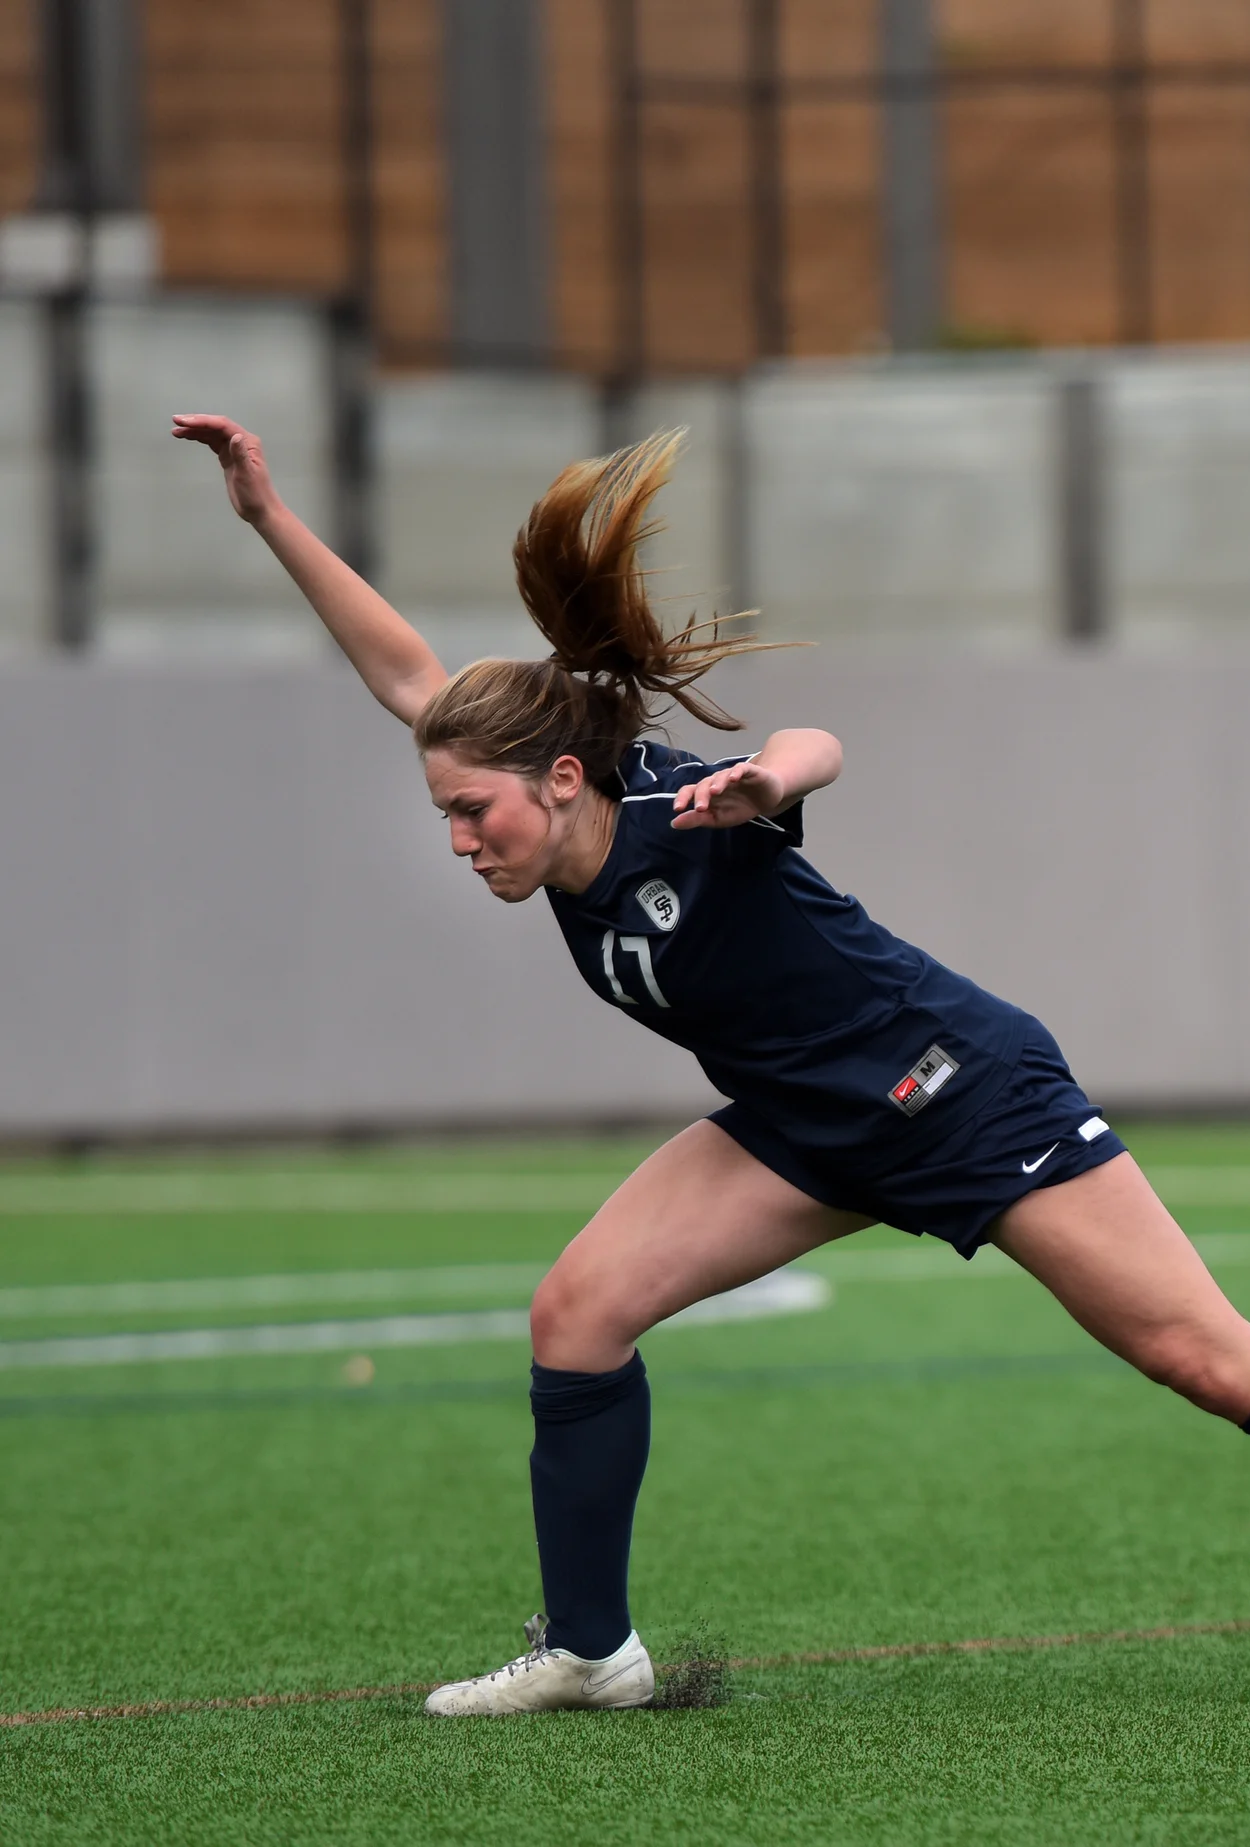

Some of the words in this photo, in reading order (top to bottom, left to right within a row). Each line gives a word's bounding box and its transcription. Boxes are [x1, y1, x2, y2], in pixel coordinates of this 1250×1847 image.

[641, 882, 669, 904] URBAN
[601, 928, 672, 1008] 17
[920, 1060, 936, 1077] M
